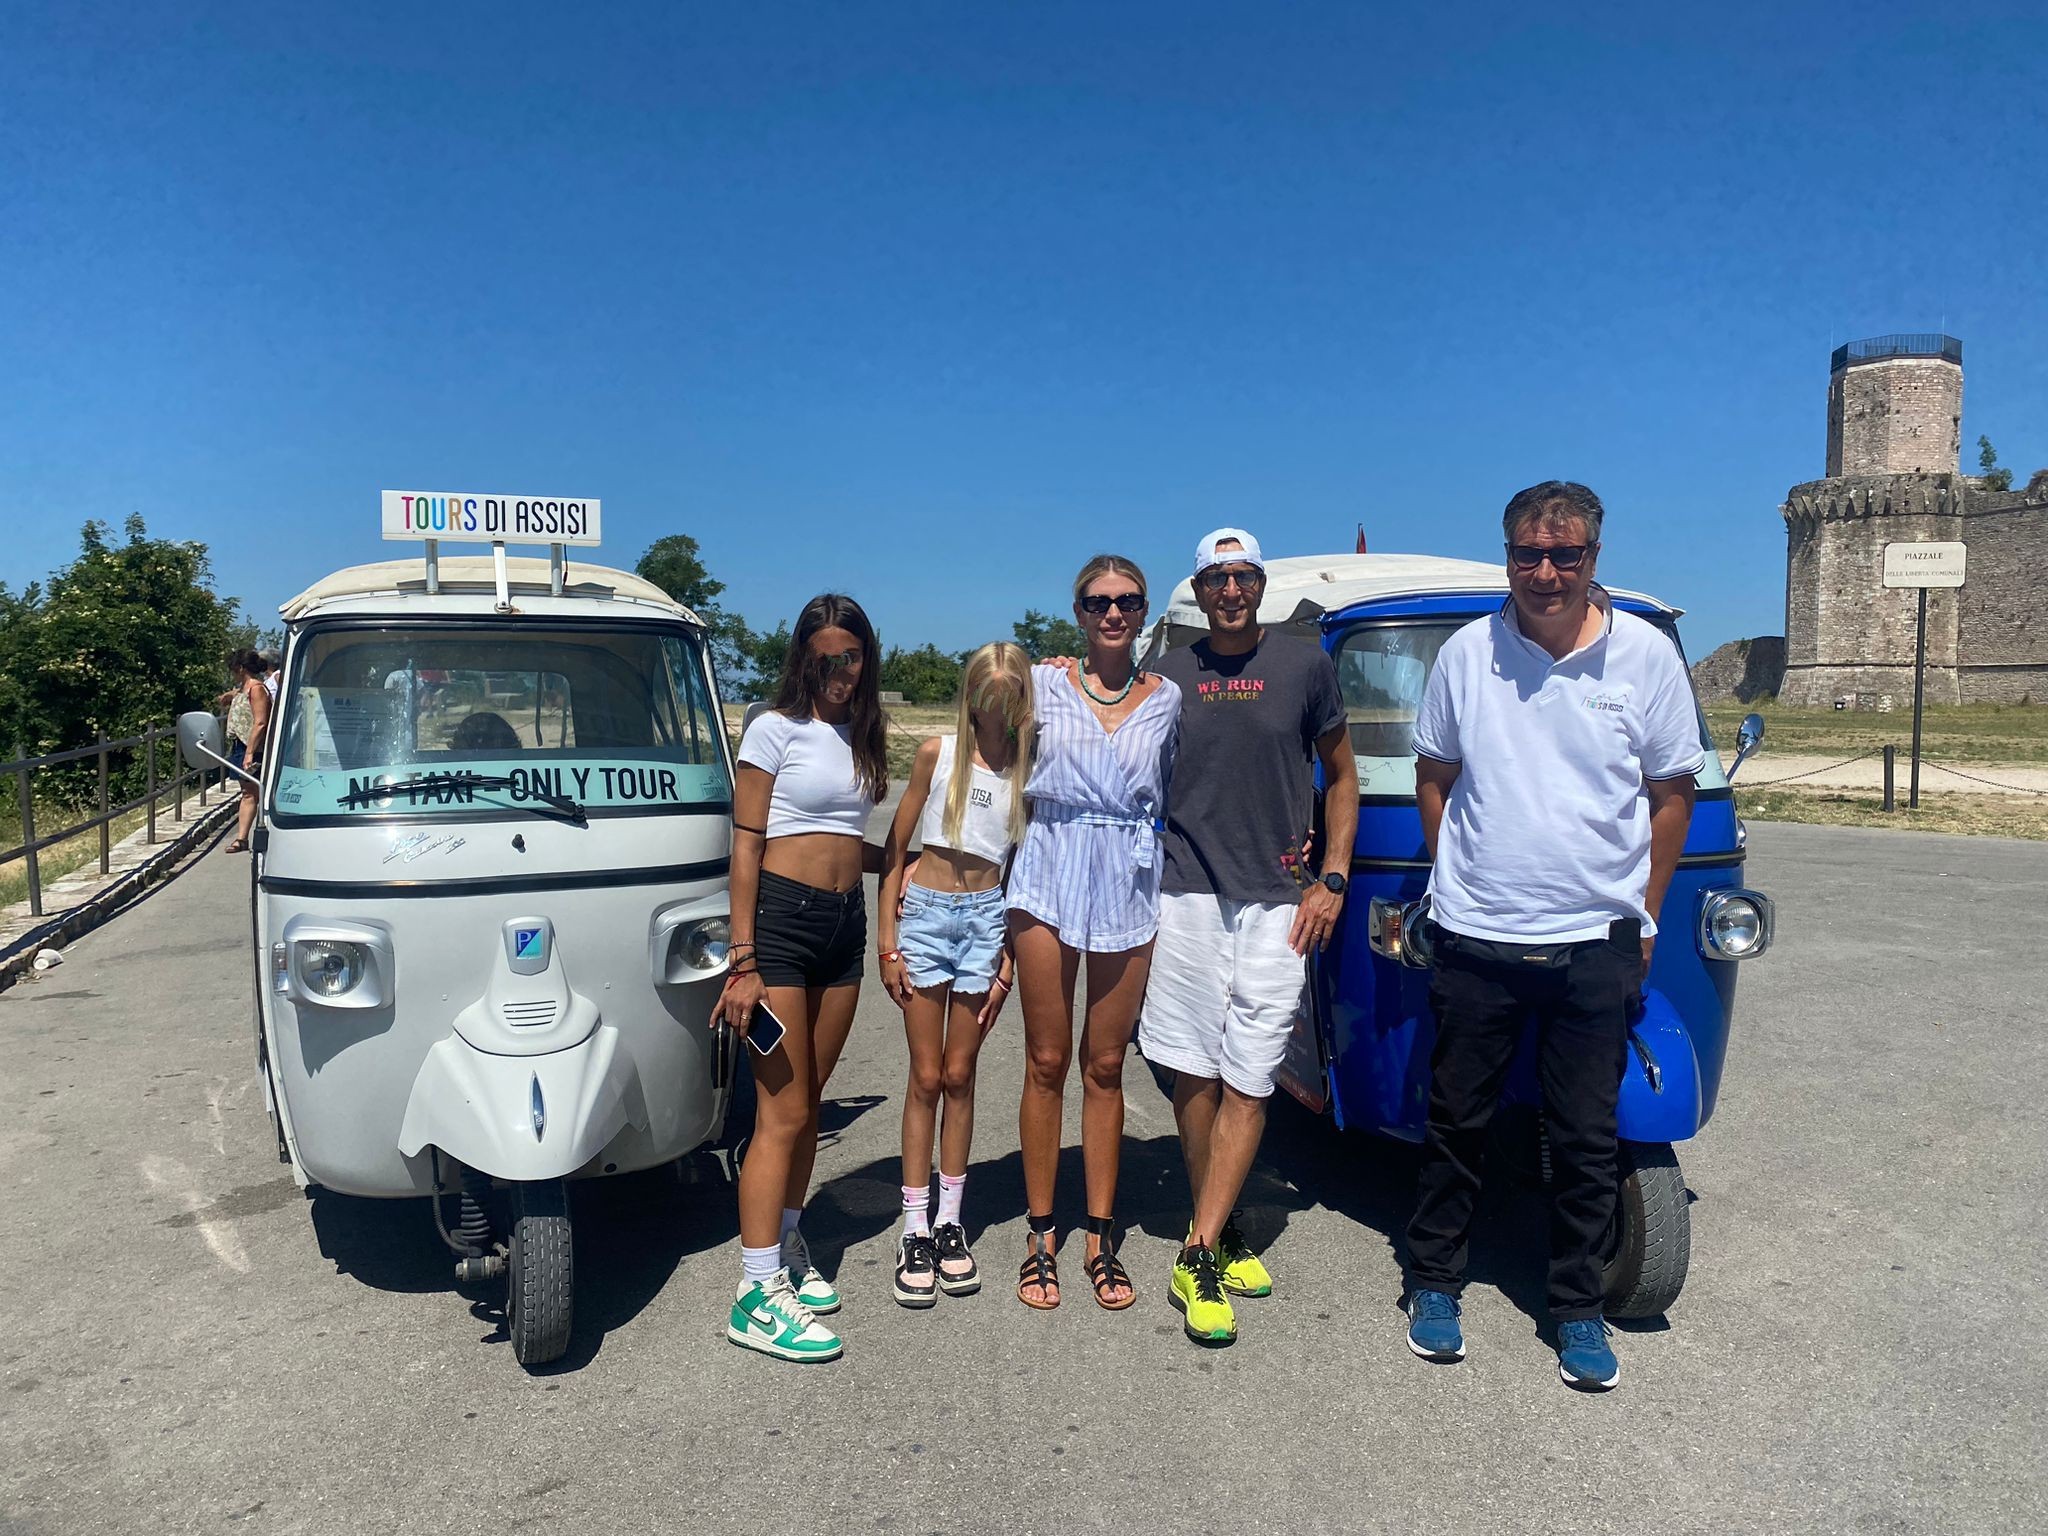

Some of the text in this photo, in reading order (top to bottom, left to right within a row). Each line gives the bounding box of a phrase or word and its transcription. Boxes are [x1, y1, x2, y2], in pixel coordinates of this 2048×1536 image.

[401, 496, 587, 535] TOURS DI ASSISI
[1904, 552, 1944, 560] PIAZZALE
[1197, 679, 1264, 694] WE RUN
[1203, 691, 1260, 702] IN PEACE
[405, 769, 474, 806] TAXI
[509, 767, 591, 801] ONLY
[599, 767, 680, 801] TOUR
[972, 788, 992, 806] USA
[517, 932, 532, 952] P
